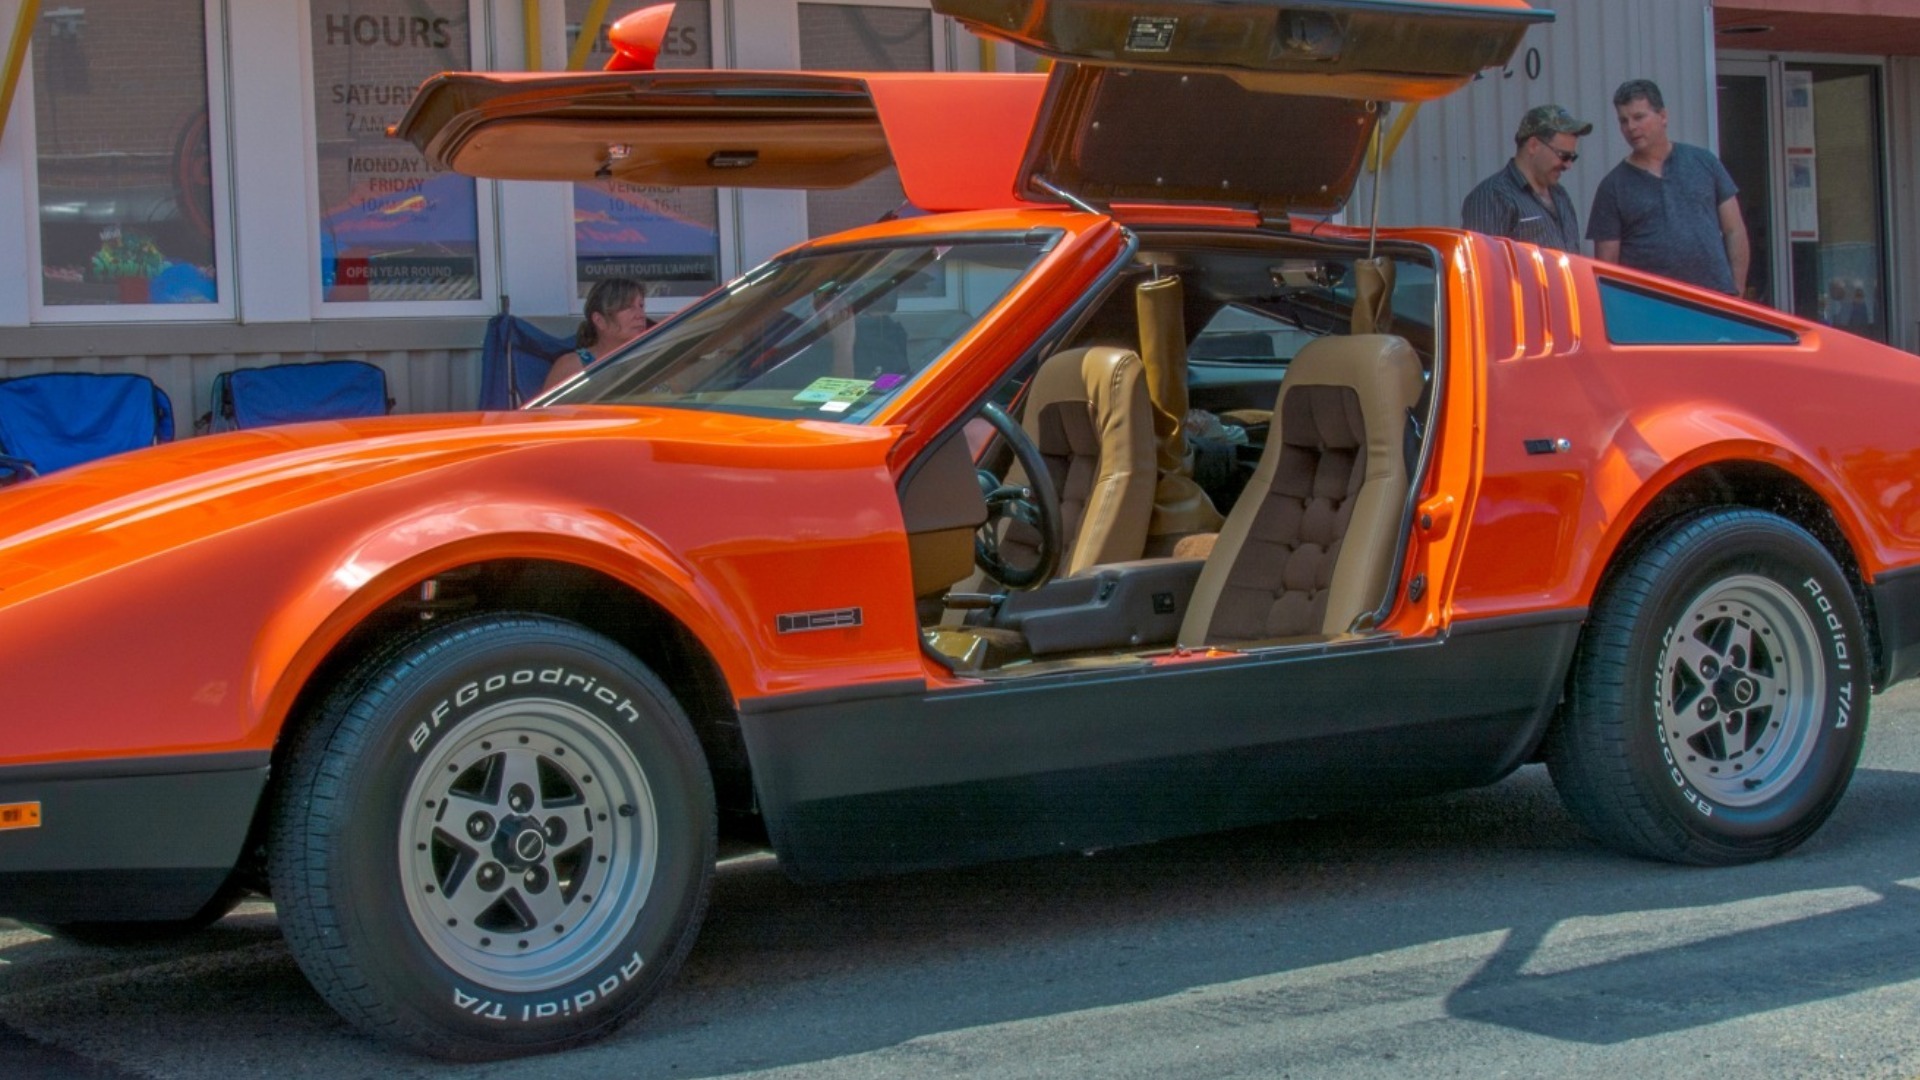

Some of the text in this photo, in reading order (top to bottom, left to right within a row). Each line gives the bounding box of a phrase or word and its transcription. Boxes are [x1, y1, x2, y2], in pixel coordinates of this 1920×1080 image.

[325, 14, 452, 48] HOURS
[348, 158, 419, 173] MONDAY
[369, 178, 425, 193] FRIDAY
[346, 265, 451, 278] OPEN YEAR ROUND
[585, 264, 627, 275] OUVERT
[629, 263, 663, 275] TOUTE
[1803, 577, 1852, 729] Radial T/A
[408, 667, 640, 753] BFGoodrich
[454, 951, 645, 1022] Radial T/A
